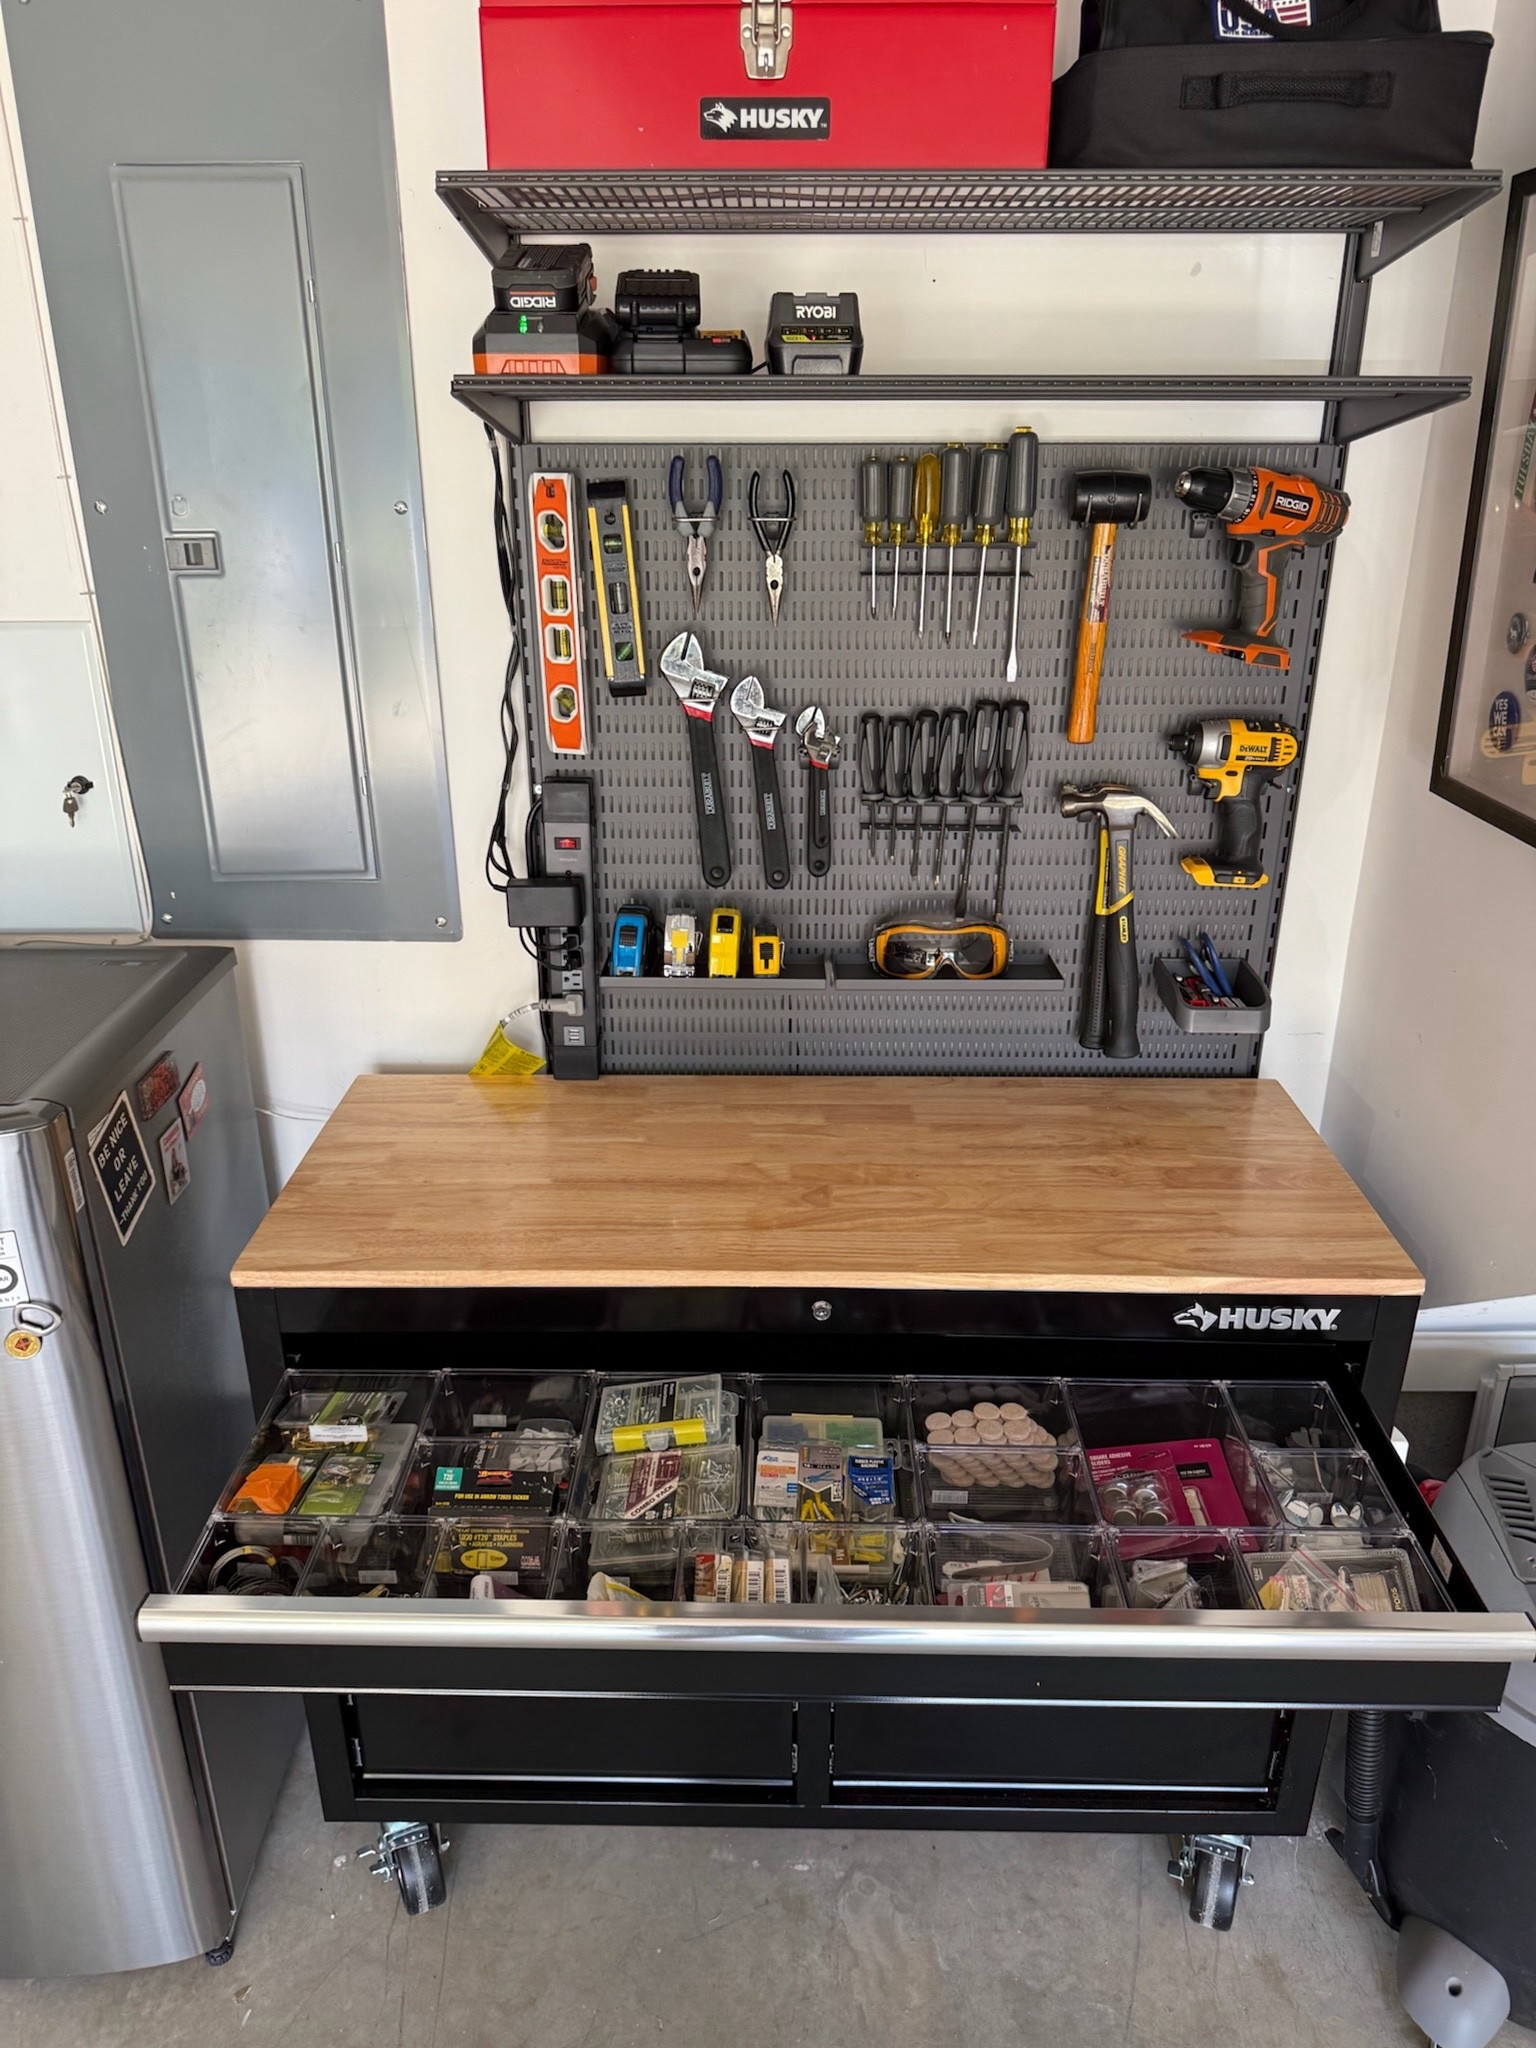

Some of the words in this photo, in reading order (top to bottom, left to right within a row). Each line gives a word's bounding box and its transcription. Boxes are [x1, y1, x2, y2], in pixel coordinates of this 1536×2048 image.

[740, 108, 824, 128] HUSKY
[510, 296, 557, 309] RIDGID
[795, 305, 837, 319] RYOBI
[1275, 496, 1310, 512] RIDGID
[1495, 699, 1509, 710] YES
[1493, 711, 1508, 725] WE
[1492, 726, 1507, 737] CAN
[1117, 845, 1127, 894] GRAPHITE
[1120, 917, 1129, 941] STANLEY
[98, 1144, 112, 1169] BE
[109, 1112, 128, 1148] NICE
[113, 1148, 127, 1171] OR
[114, 1155, 139, 1202] LEAVE
[136, 1169, 148, 1191] YOU
[1218, 1307, 1342, 1330] HUSKY
[1089, 1453, 1108, 1461] SQUARE
[1108, 1451, 1132, 1459] ADHESIVE
[630, 1498, 656, 1517] COMBO
[656, 1484, 674, 1500] PACK
